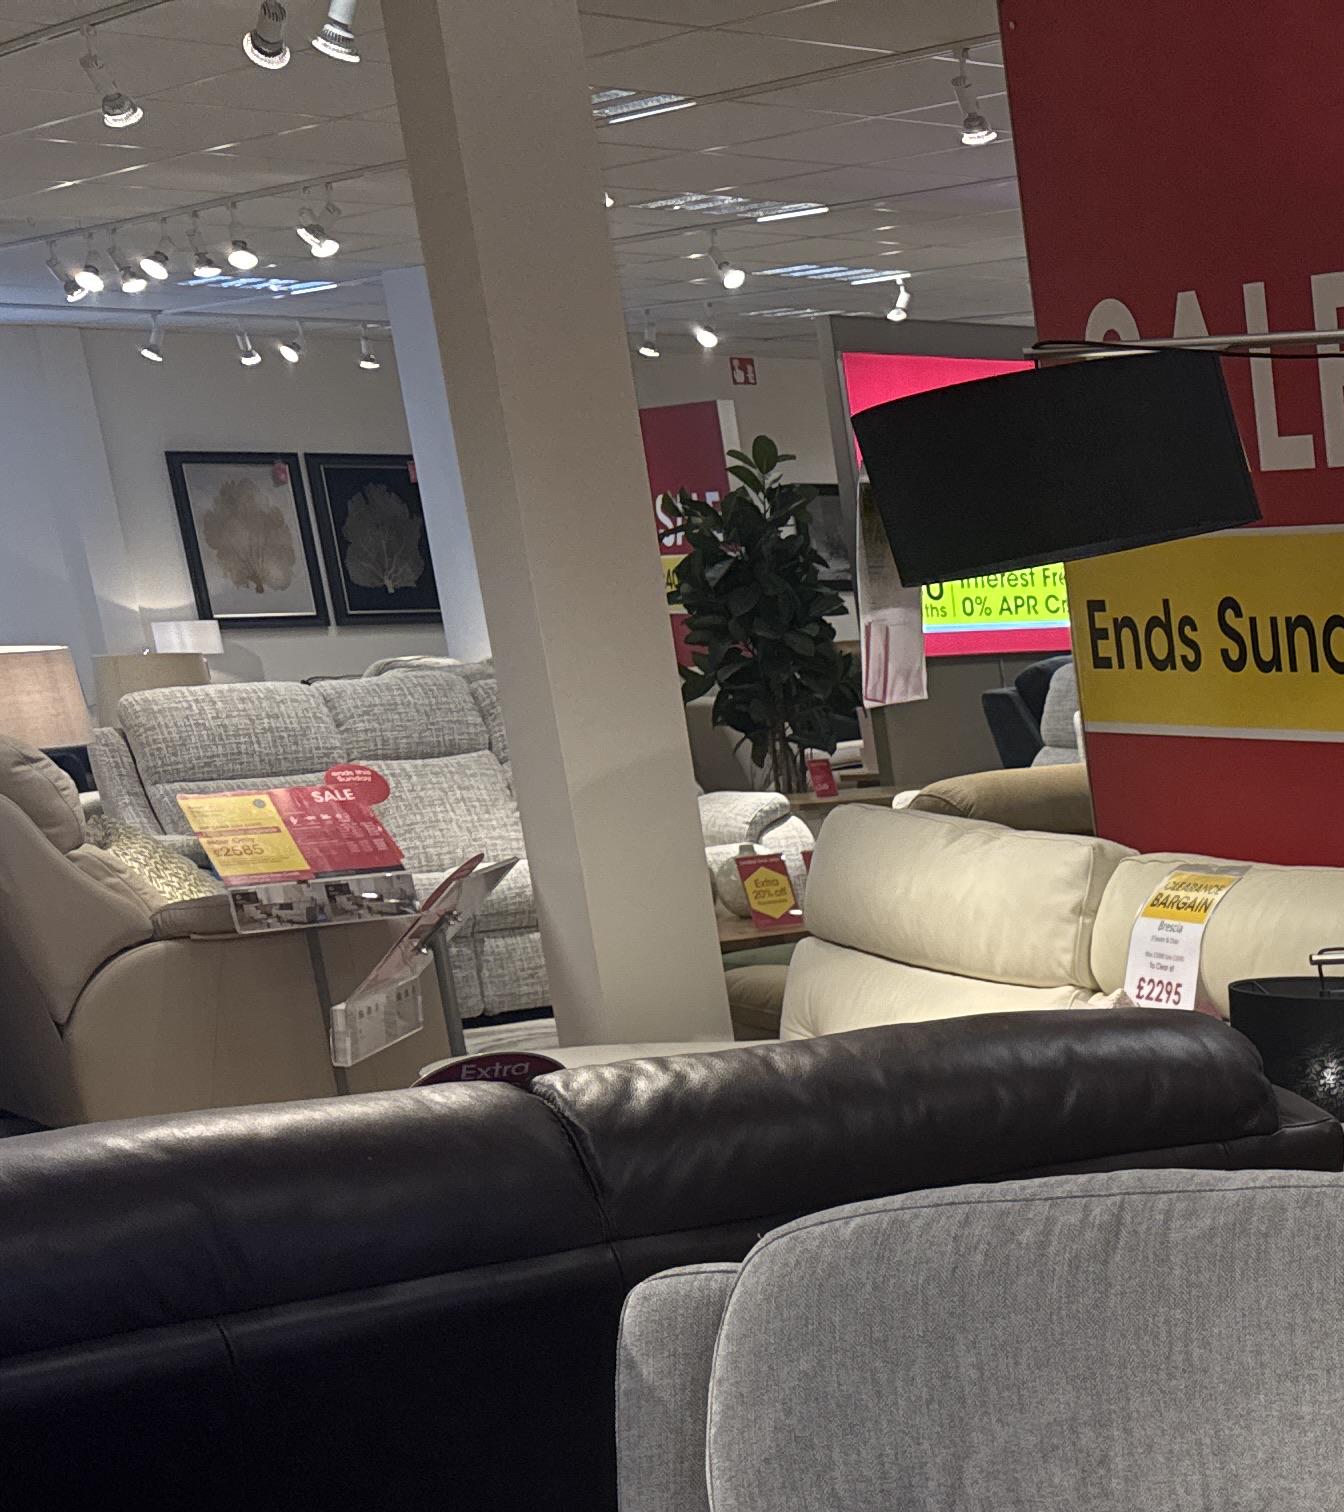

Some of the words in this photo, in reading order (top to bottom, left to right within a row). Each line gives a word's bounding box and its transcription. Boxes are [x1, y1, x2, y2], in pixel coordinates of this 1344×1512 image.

[962, 596, 992, 617] 0%
[999, 595, 1039, 616] APR
[1086, 598, 1201, 673] Ends
[311, 788, 356, 803] SALE
[1150, 892, 1214, 914] BARGAIN
[1135, 977, 1183, 1006] £2295
[460, 1061, 530, 1080] Extra
